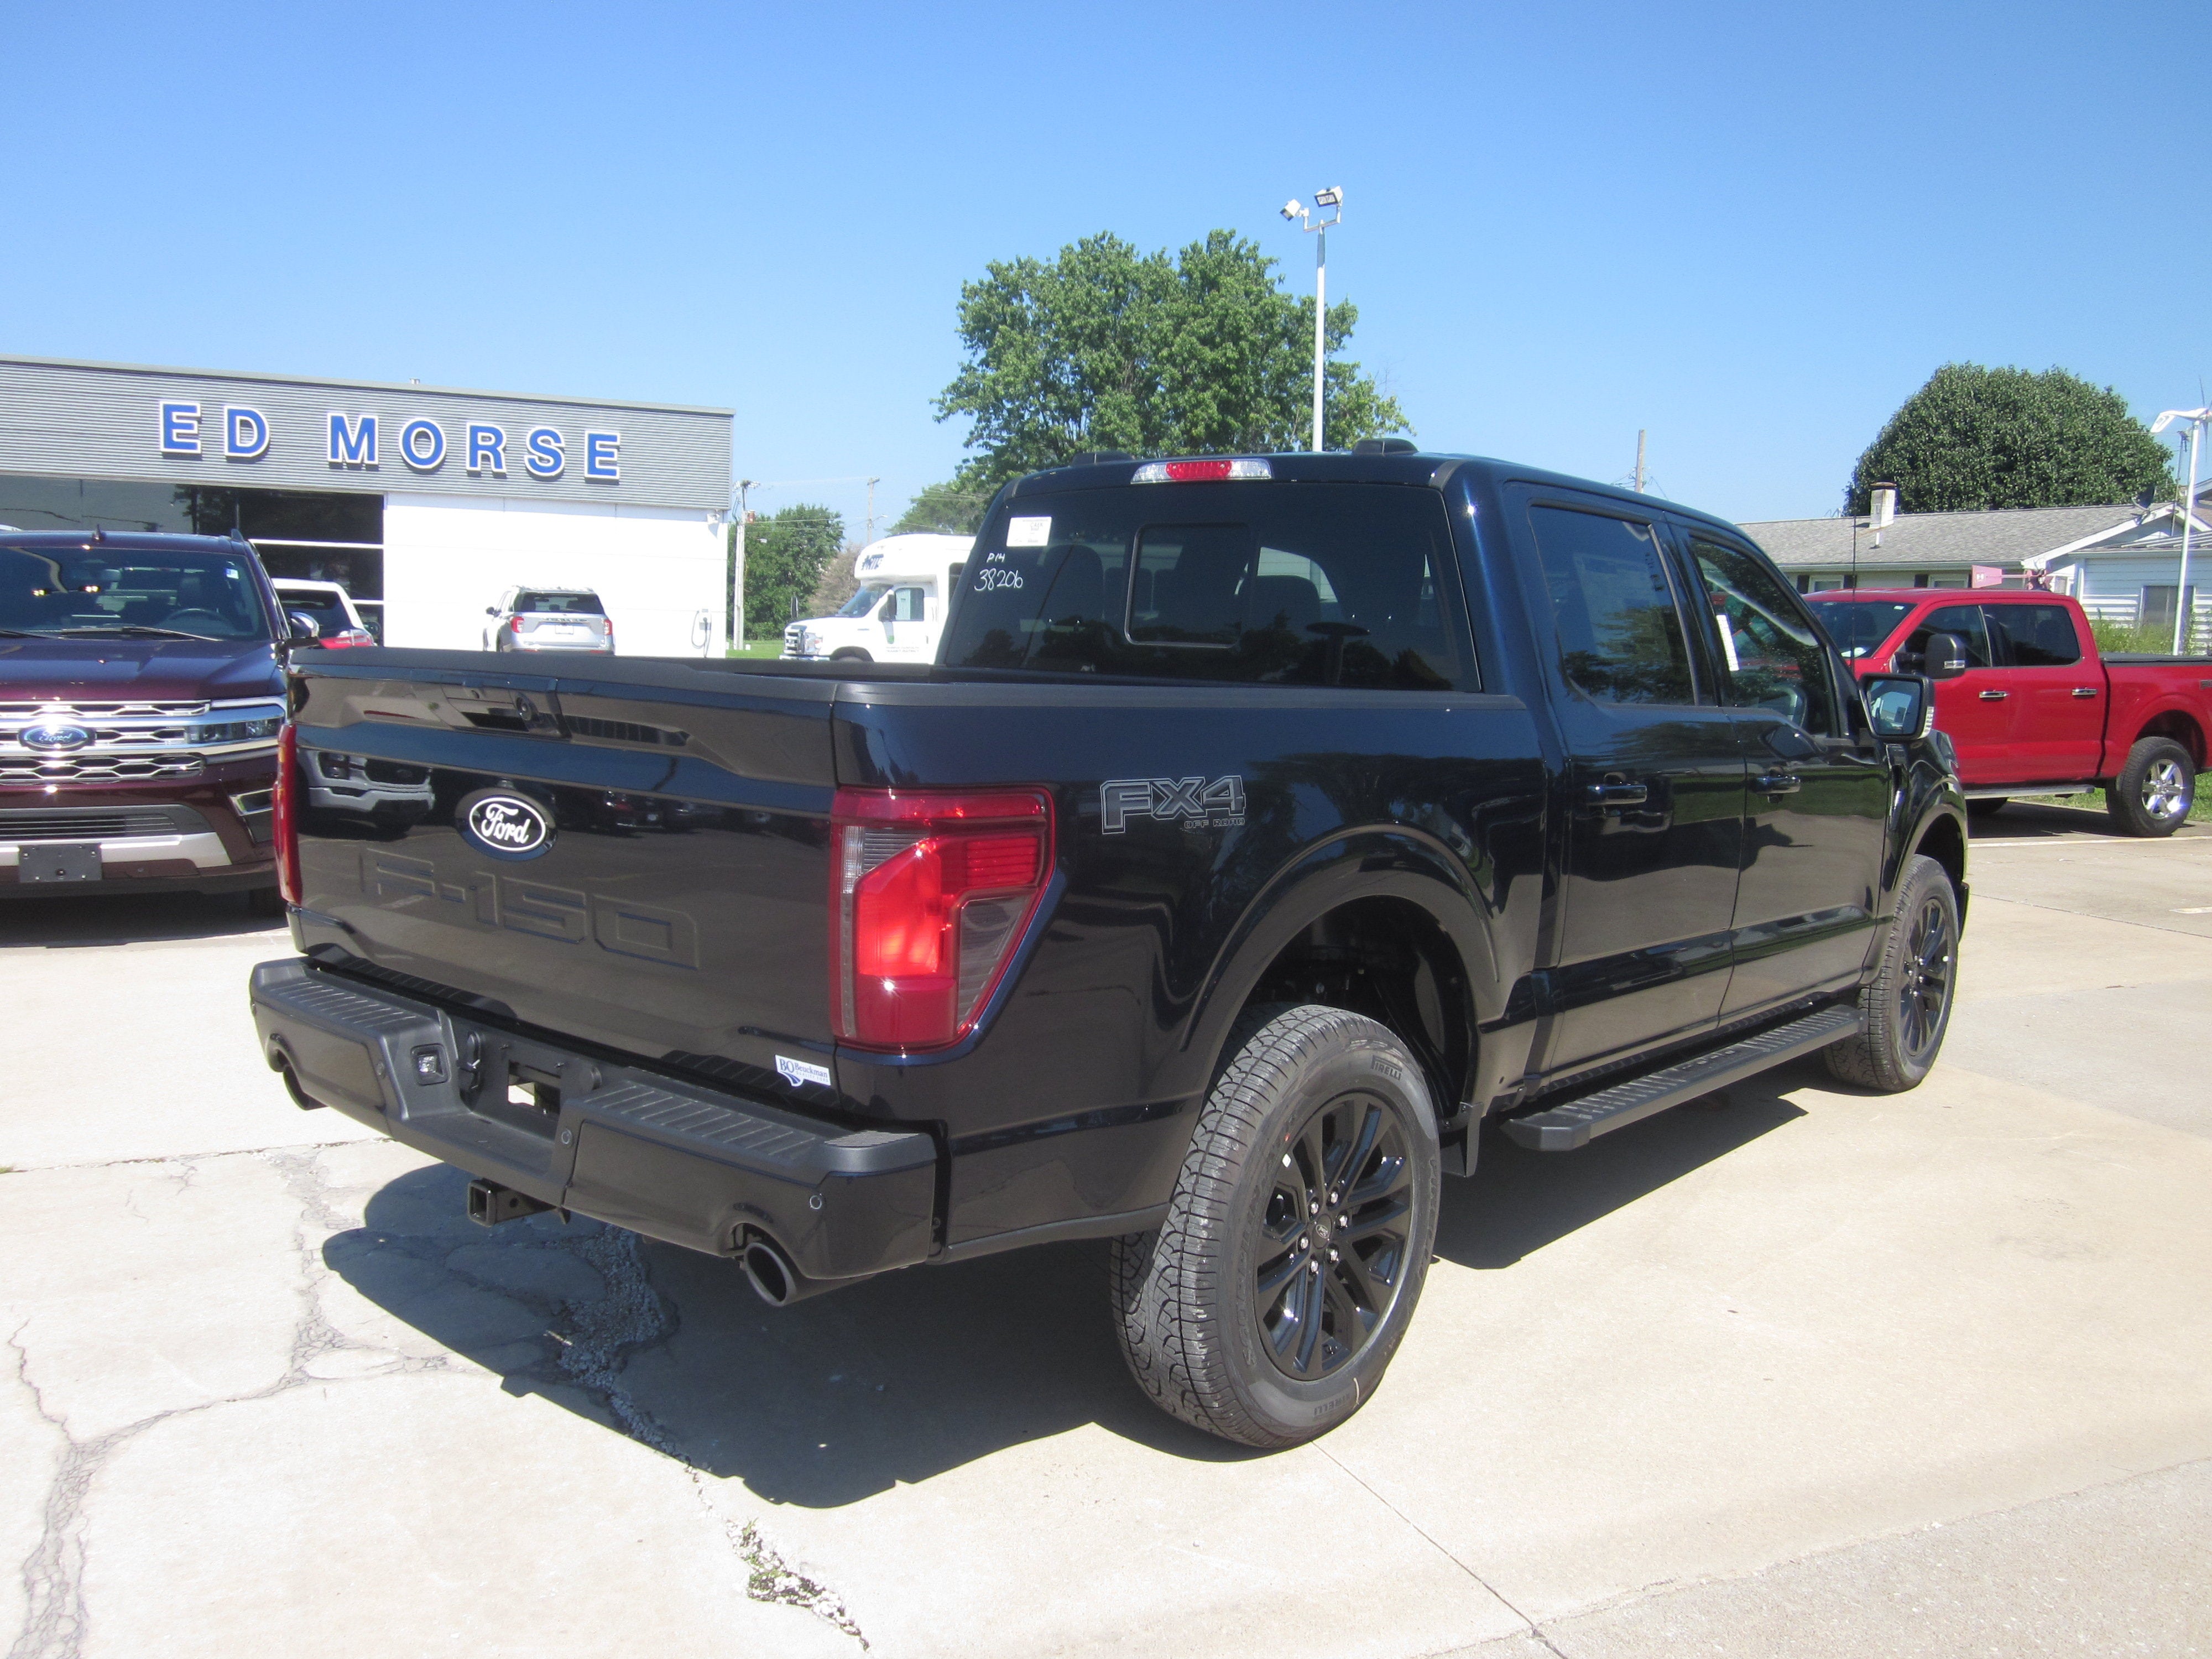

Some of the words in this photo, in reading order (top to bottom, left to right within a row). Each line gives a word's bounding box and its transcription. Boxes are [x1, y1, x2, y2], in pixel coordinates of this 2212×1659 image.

[160, 400, 271, 458] ED
[326, 413, 621, 481] MORSE
[986, 552, 1006, 563] P14
[974, 568, 1023, 591] 38206
[1099, 775, 1246, 834] FX4
[481, 803, 531, 844] Ford
[1184, 820, 1209, 829] OFF
[1213, 817, 1245, 827] ROAD
[359, 846, 701, 970] F-150
[795, 1062, 828, 1078] Beuckman
[1371, 1055, 1403, 1081] PIRELLI
